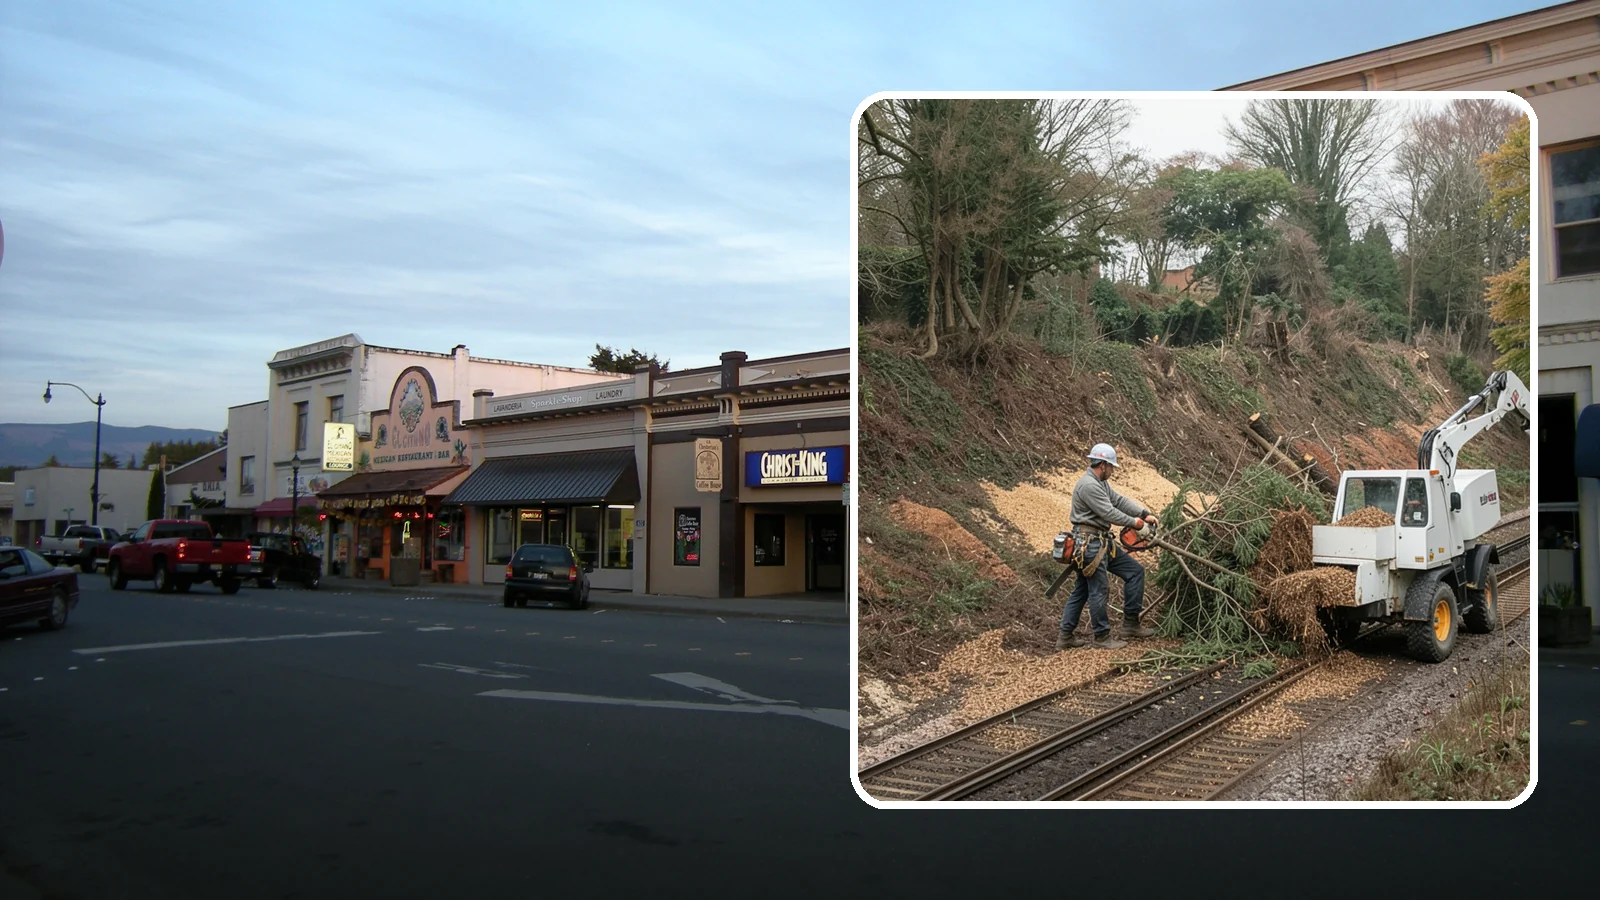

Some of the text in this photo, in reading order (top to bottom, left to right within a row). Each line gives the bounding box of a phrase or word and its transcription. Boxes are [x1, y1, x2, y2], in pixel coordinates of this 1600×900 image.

[530, 394, 582, 409] Sparkle Shop
[595, 388, 624, 400] LAUNDRY
[493, 402, 523, 413] LAVANDERIA
[373, 455, 397, 465] MEXICAN
[397, 451, 434, 463] RESTAURANT
[438, 450, 450, 460] BAR
[761, 450, 828, 479] CHRIST KING
